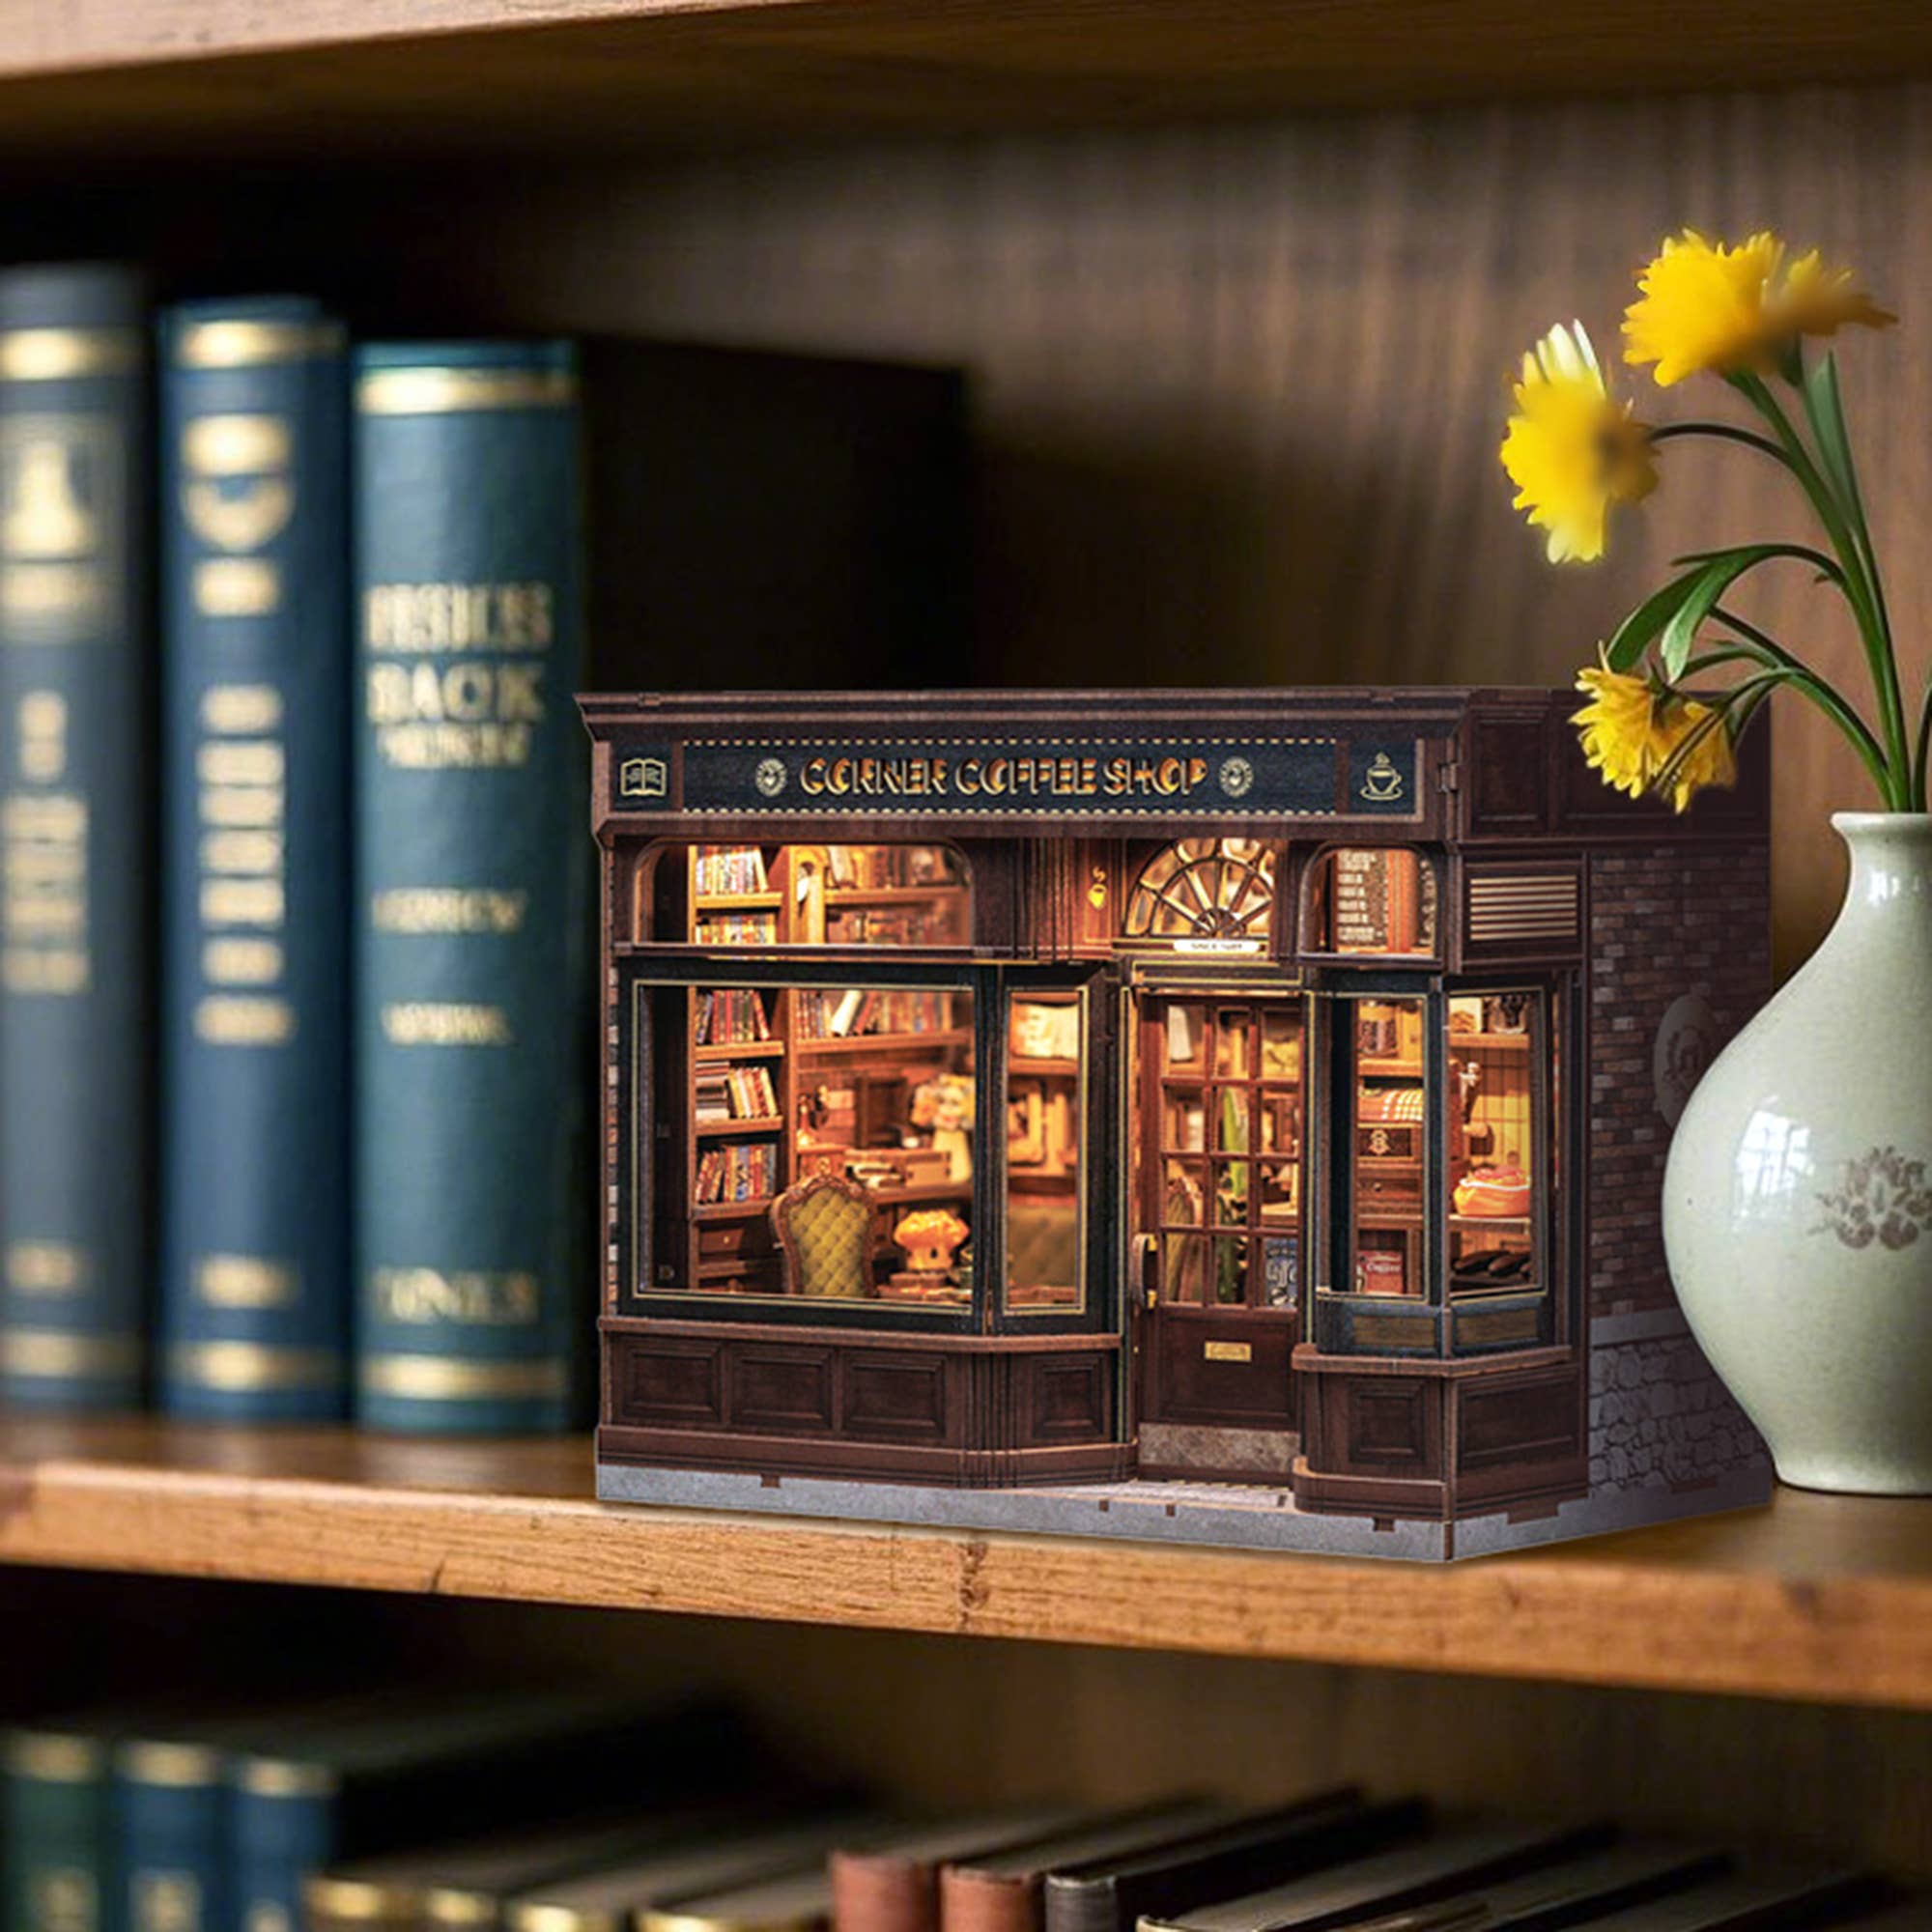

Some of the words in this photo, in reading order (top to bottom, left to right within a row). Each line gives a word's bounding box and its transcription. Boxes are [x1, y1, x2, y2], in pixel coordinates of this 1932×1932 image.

[800, 757, 948, 795] CORNER
[954, 757, 1097, 795] COFFEE
[1102, 757, 1207, 795] SHOP
